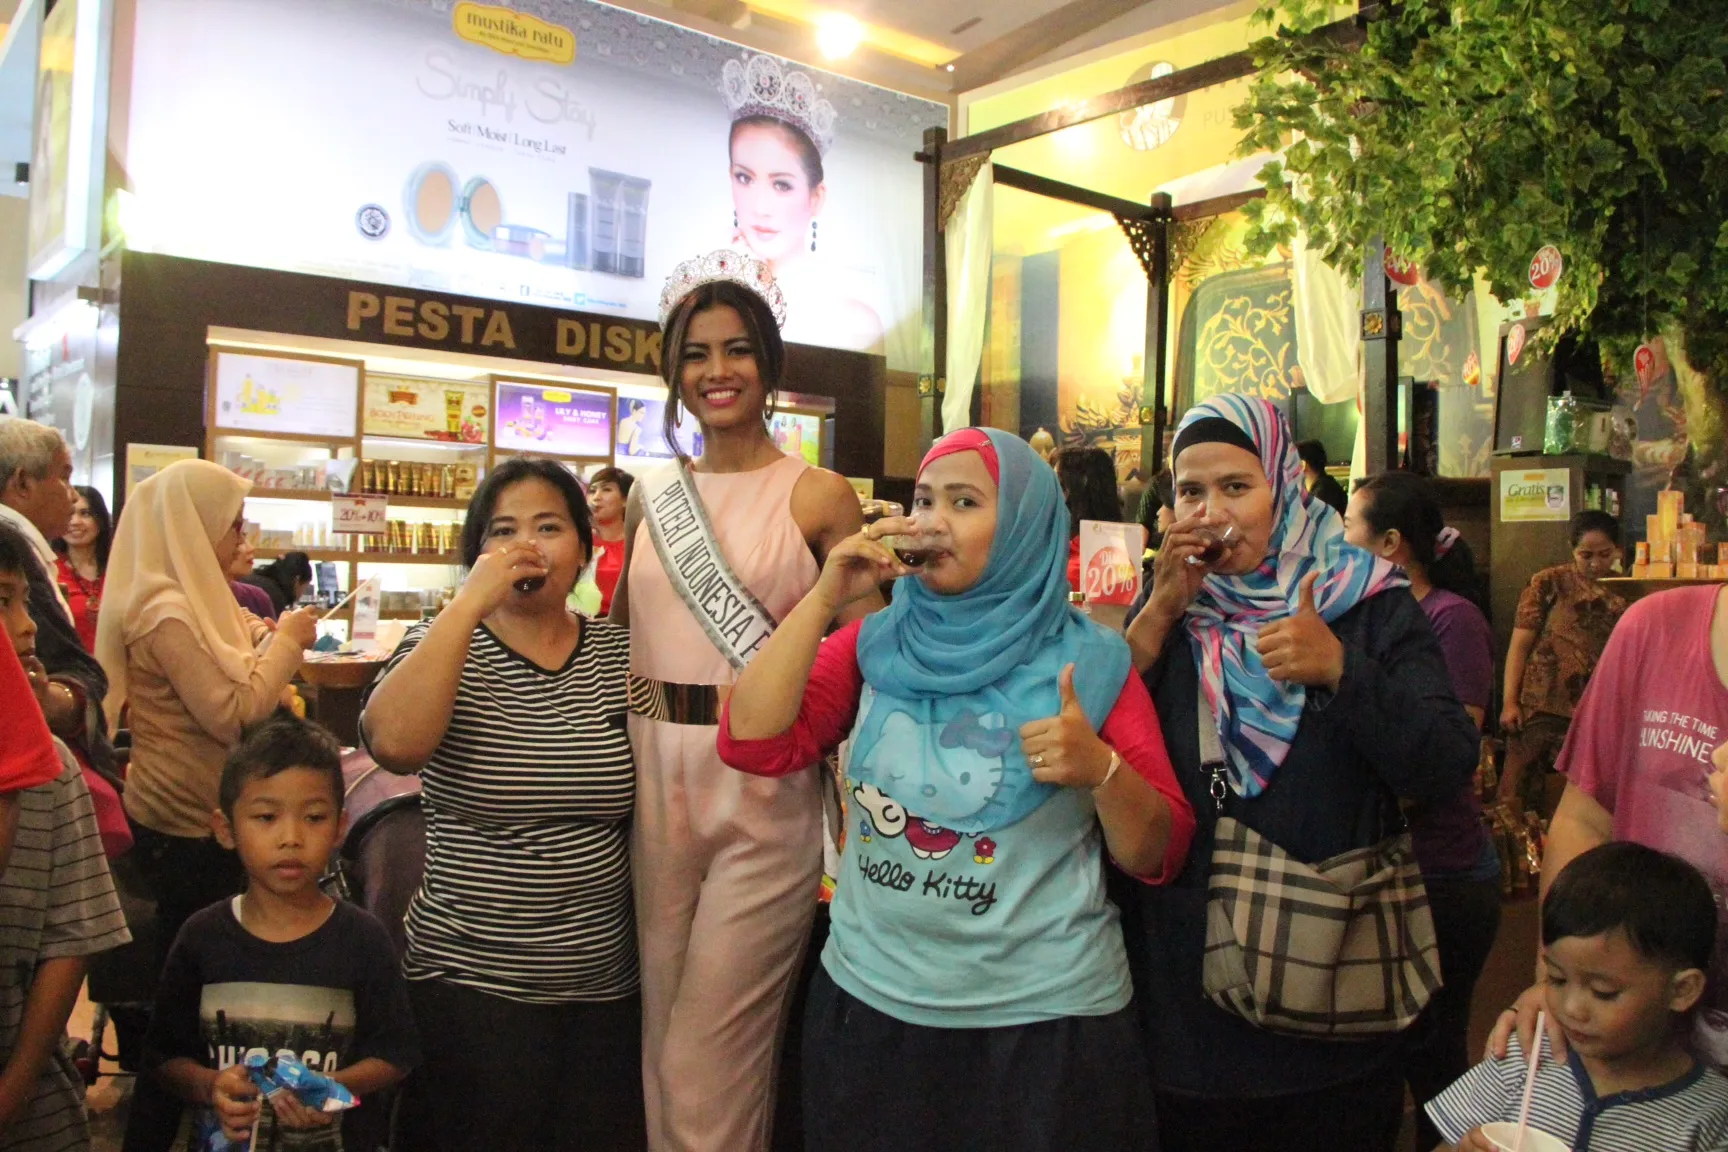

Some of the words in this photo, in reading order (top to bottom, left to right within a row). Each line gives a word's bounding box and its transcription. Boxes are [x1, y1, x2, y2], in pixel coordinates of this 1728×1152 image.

[465, 12, 527, 39] mustika
[532, 29, 563, 48] ratu
[415, 51, 517, 123] Simply
[525, 75, 597, 141] Stay
[477, 125, 507, 143] Moist
[514, 133, 542, 153] Long
[346, 290, 516, 348] PESTA
[1508, 482, 1546, 497] Gratis
[652, 480, 700, 548] PUTERI
[674, 536, 755, 648] INDONESIA
[1087, 563, 1134, 598] 20%
[1669, 711, 1691, 729] THE
[1692, 717, 1719, 740] TIME
[859, 854, 915, 892] Hello
[922, 870, 997, 916] Kitty
